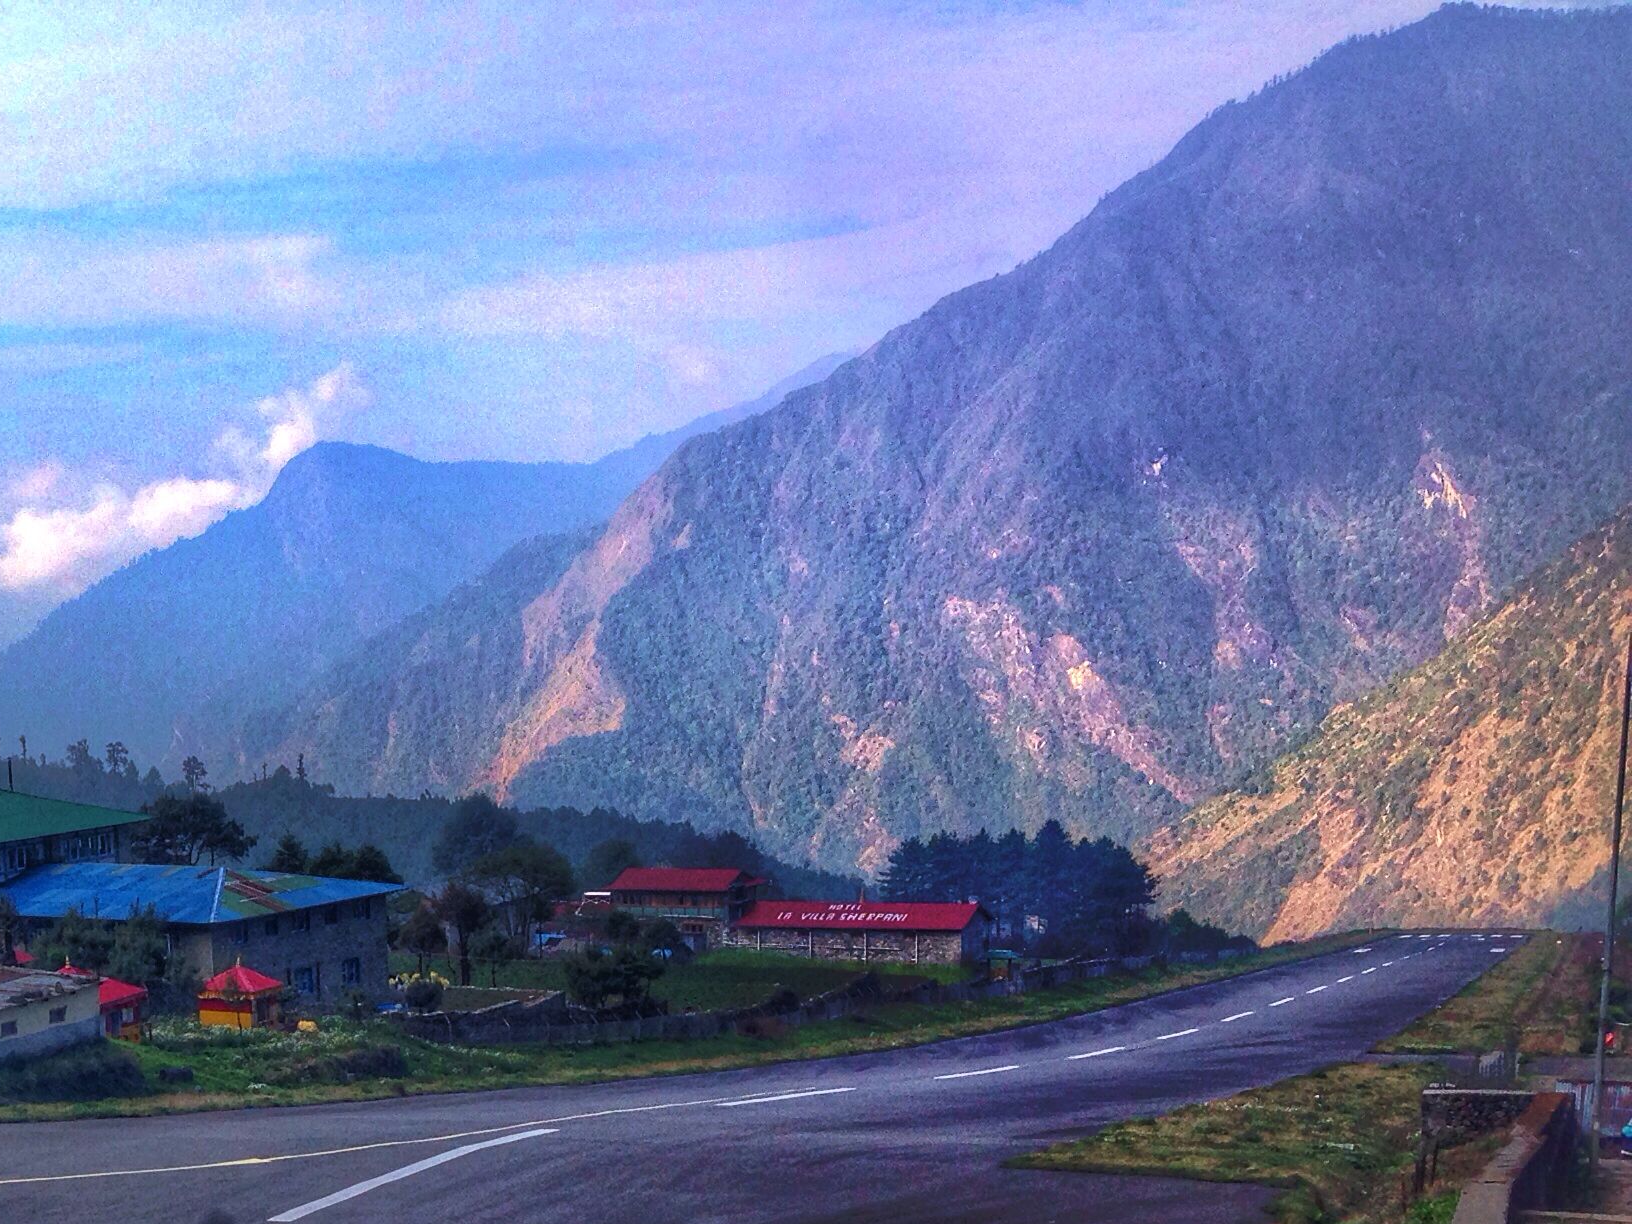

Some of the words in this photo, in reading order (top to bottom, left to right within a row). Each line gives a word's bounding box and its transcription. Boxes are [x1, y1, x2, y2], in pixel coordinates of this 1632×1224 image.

[777, 912, 792, 920] LA
[801, 912, 836, 921] VILLA
[839, 912, 909, 922] SHERPANI
